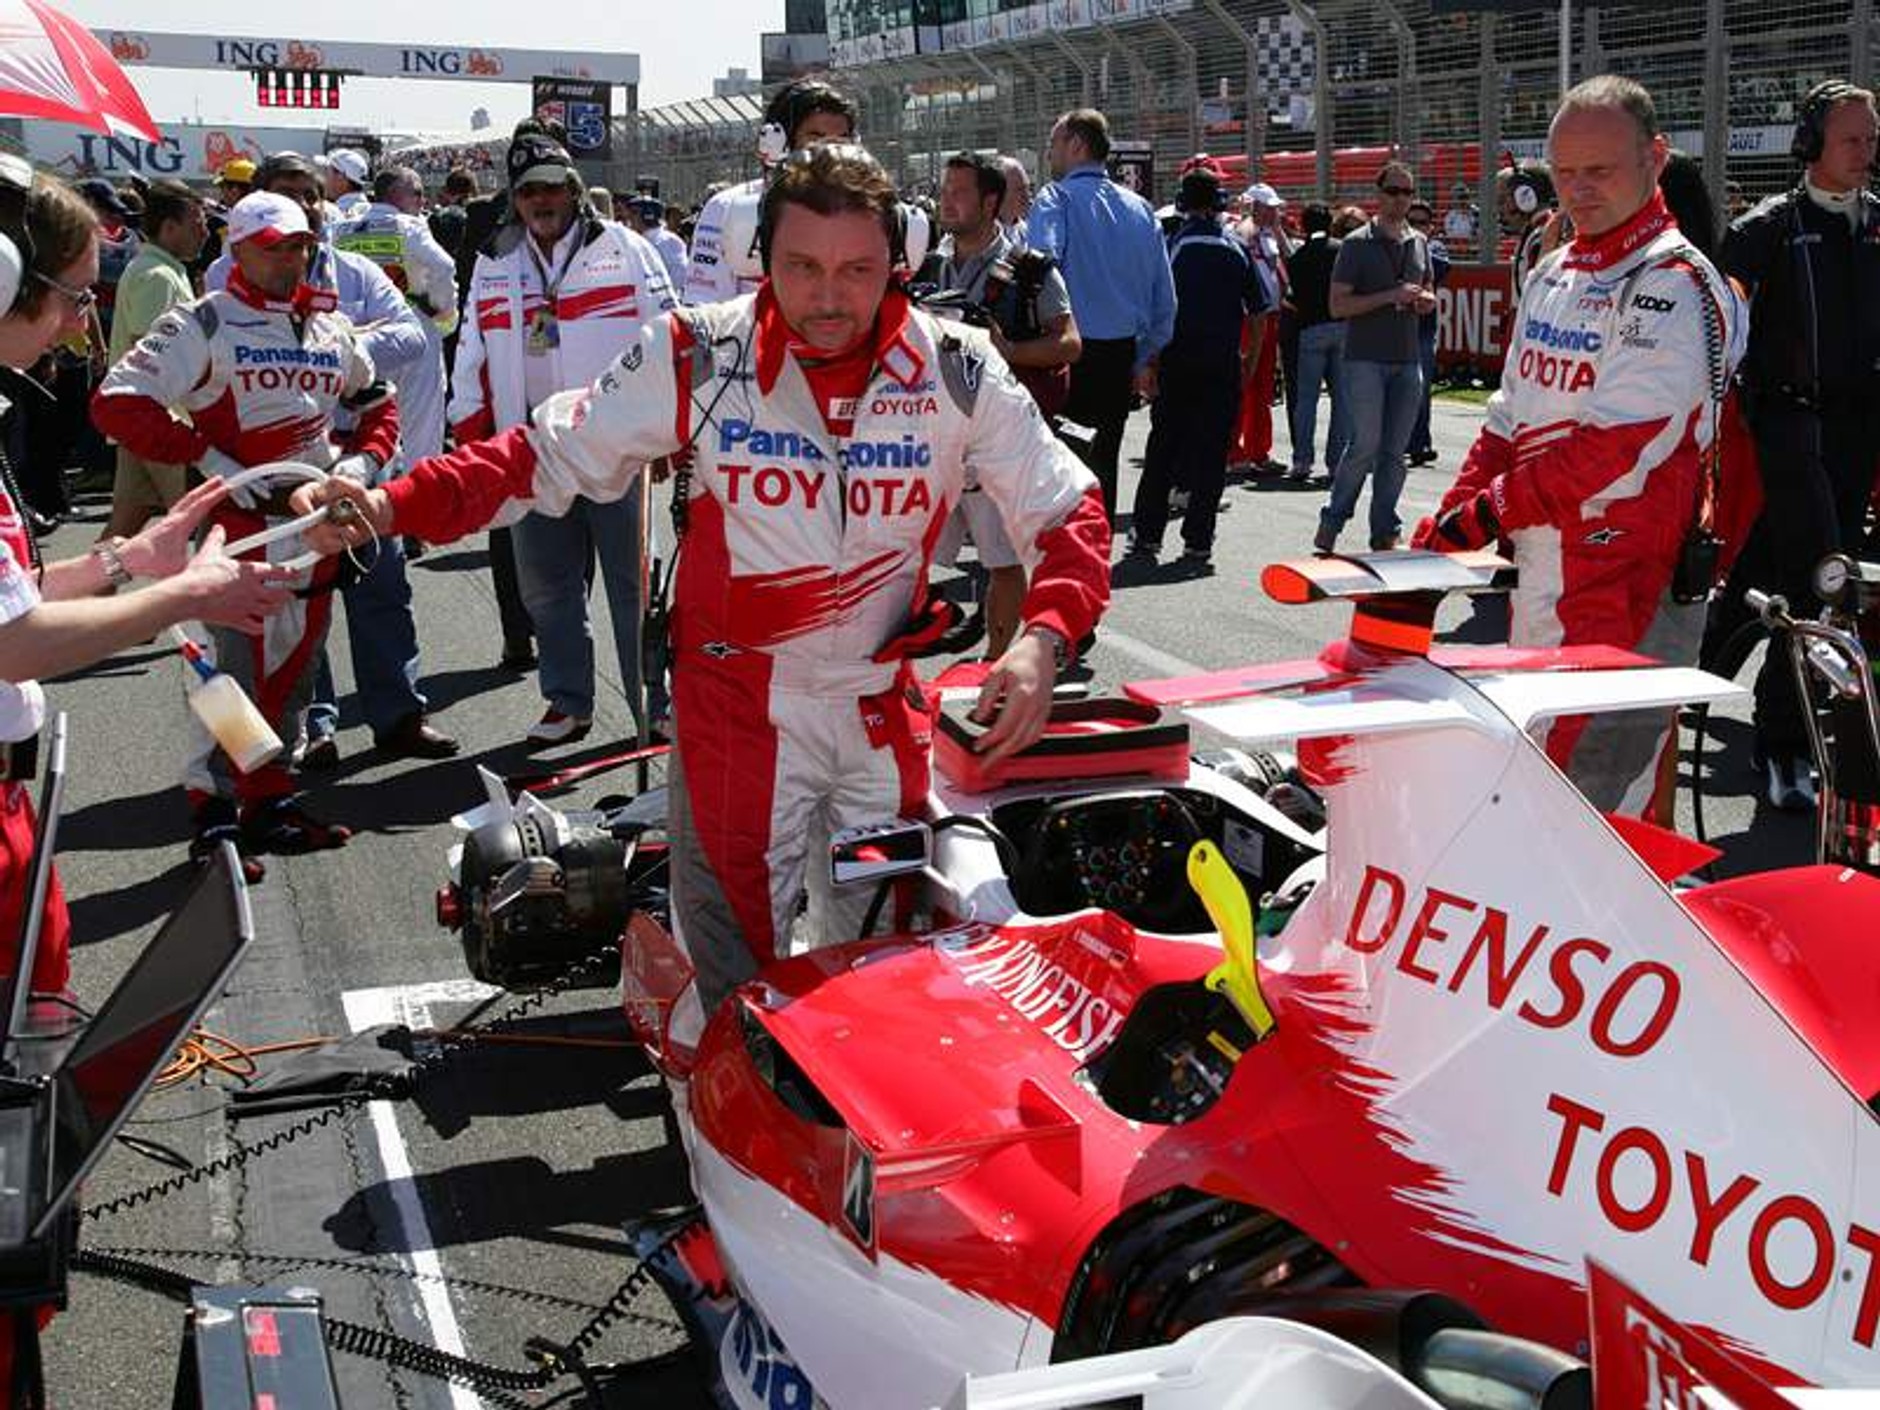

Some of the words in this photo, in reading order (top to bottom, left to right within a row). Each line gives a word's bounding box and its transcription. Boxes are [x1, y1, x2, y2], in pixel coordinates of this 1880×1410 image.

[216, 40, 278, 65] ING
[402, 50, 460, 74] ING
[77, 133, 186, 173] ING
[717, 463, 931, 517] TOYOTA
[1344, 865, 1681, 1057] DENSO
